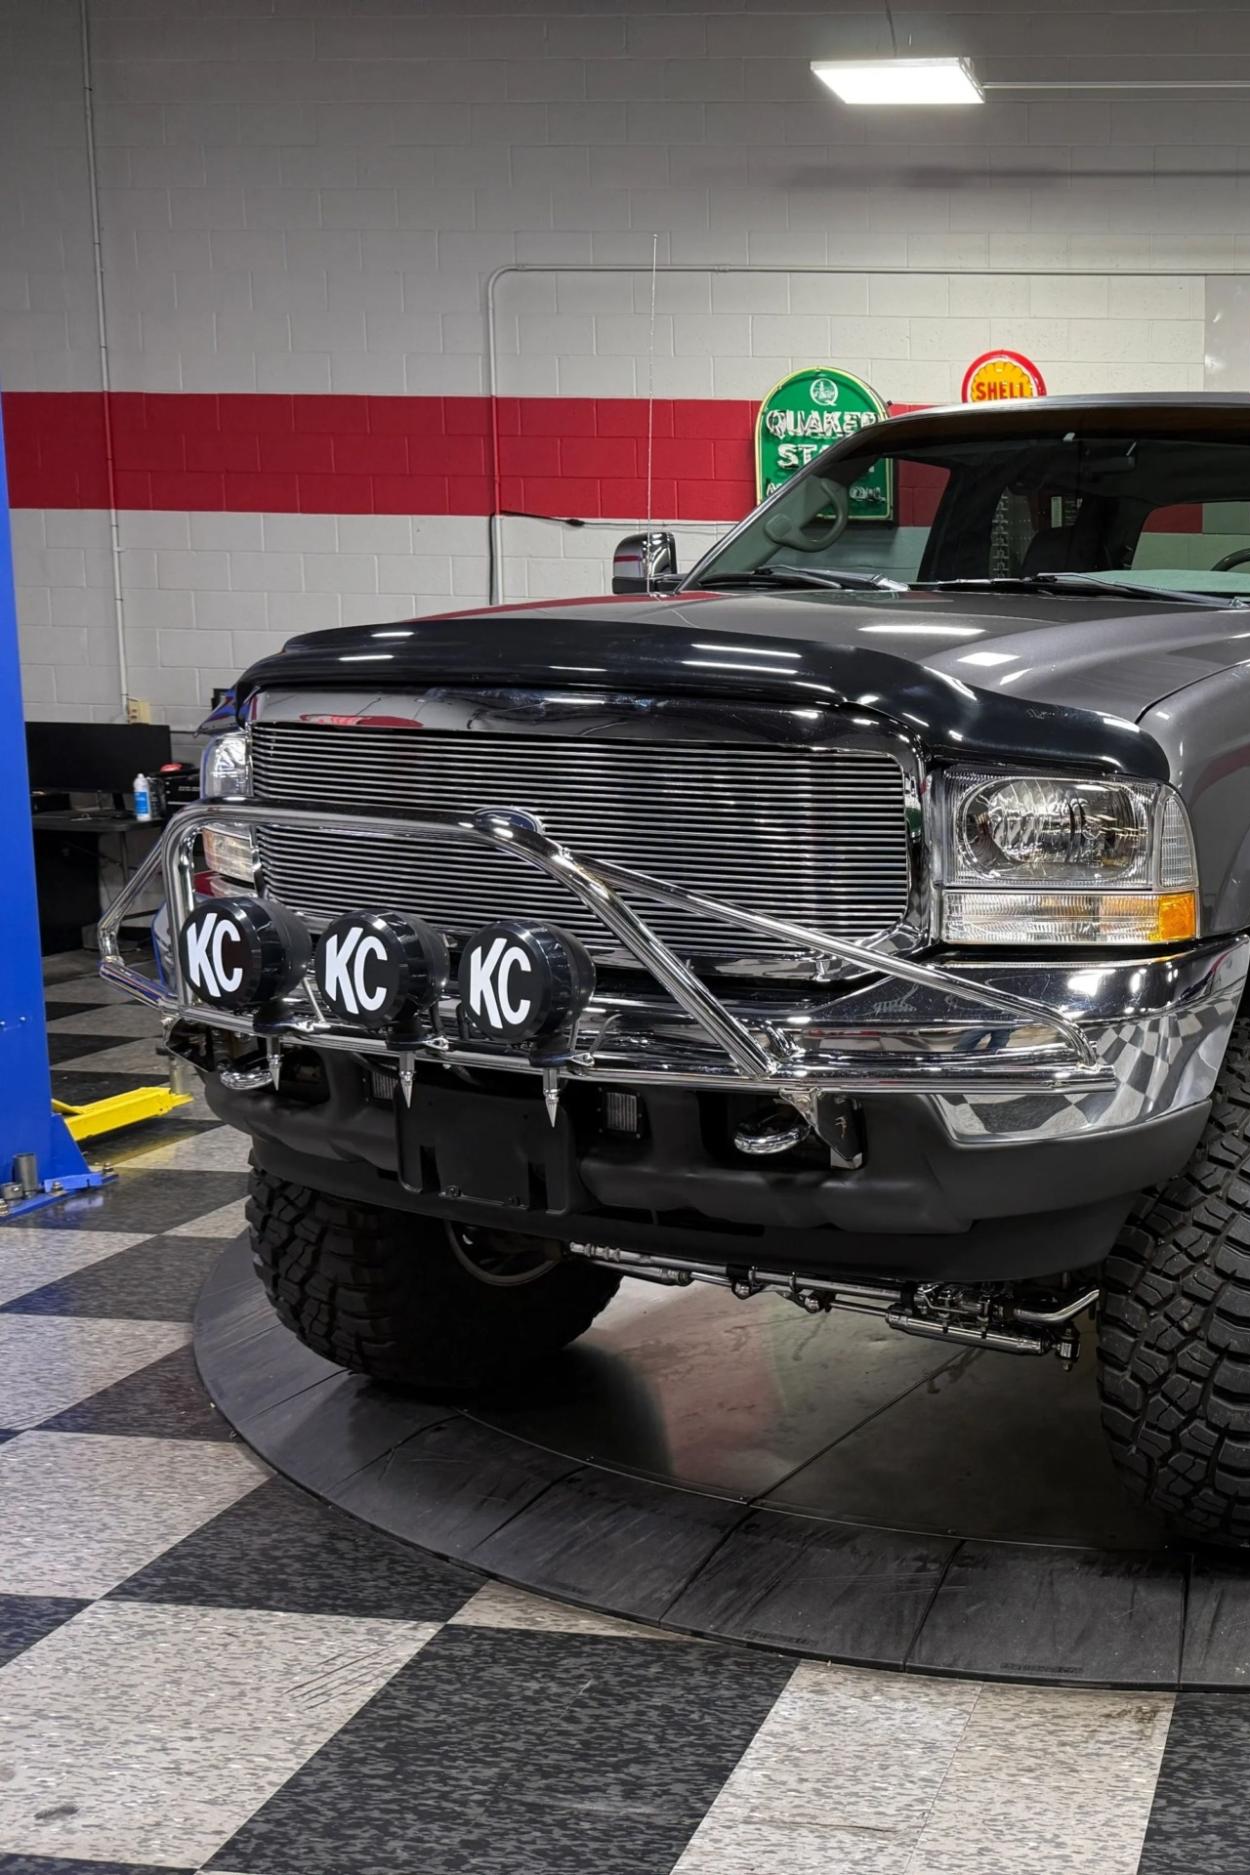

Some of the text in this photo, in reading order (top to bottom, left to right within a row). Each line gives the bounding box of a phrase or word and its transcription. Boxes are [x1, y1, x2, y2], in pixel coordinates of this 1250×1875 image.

[766, 409, 878, 440] QUAKER
[186, 912, 244, 998] KC
[325, 926, 388, 1015] KC
[469, 937, 532, 1030] KC
